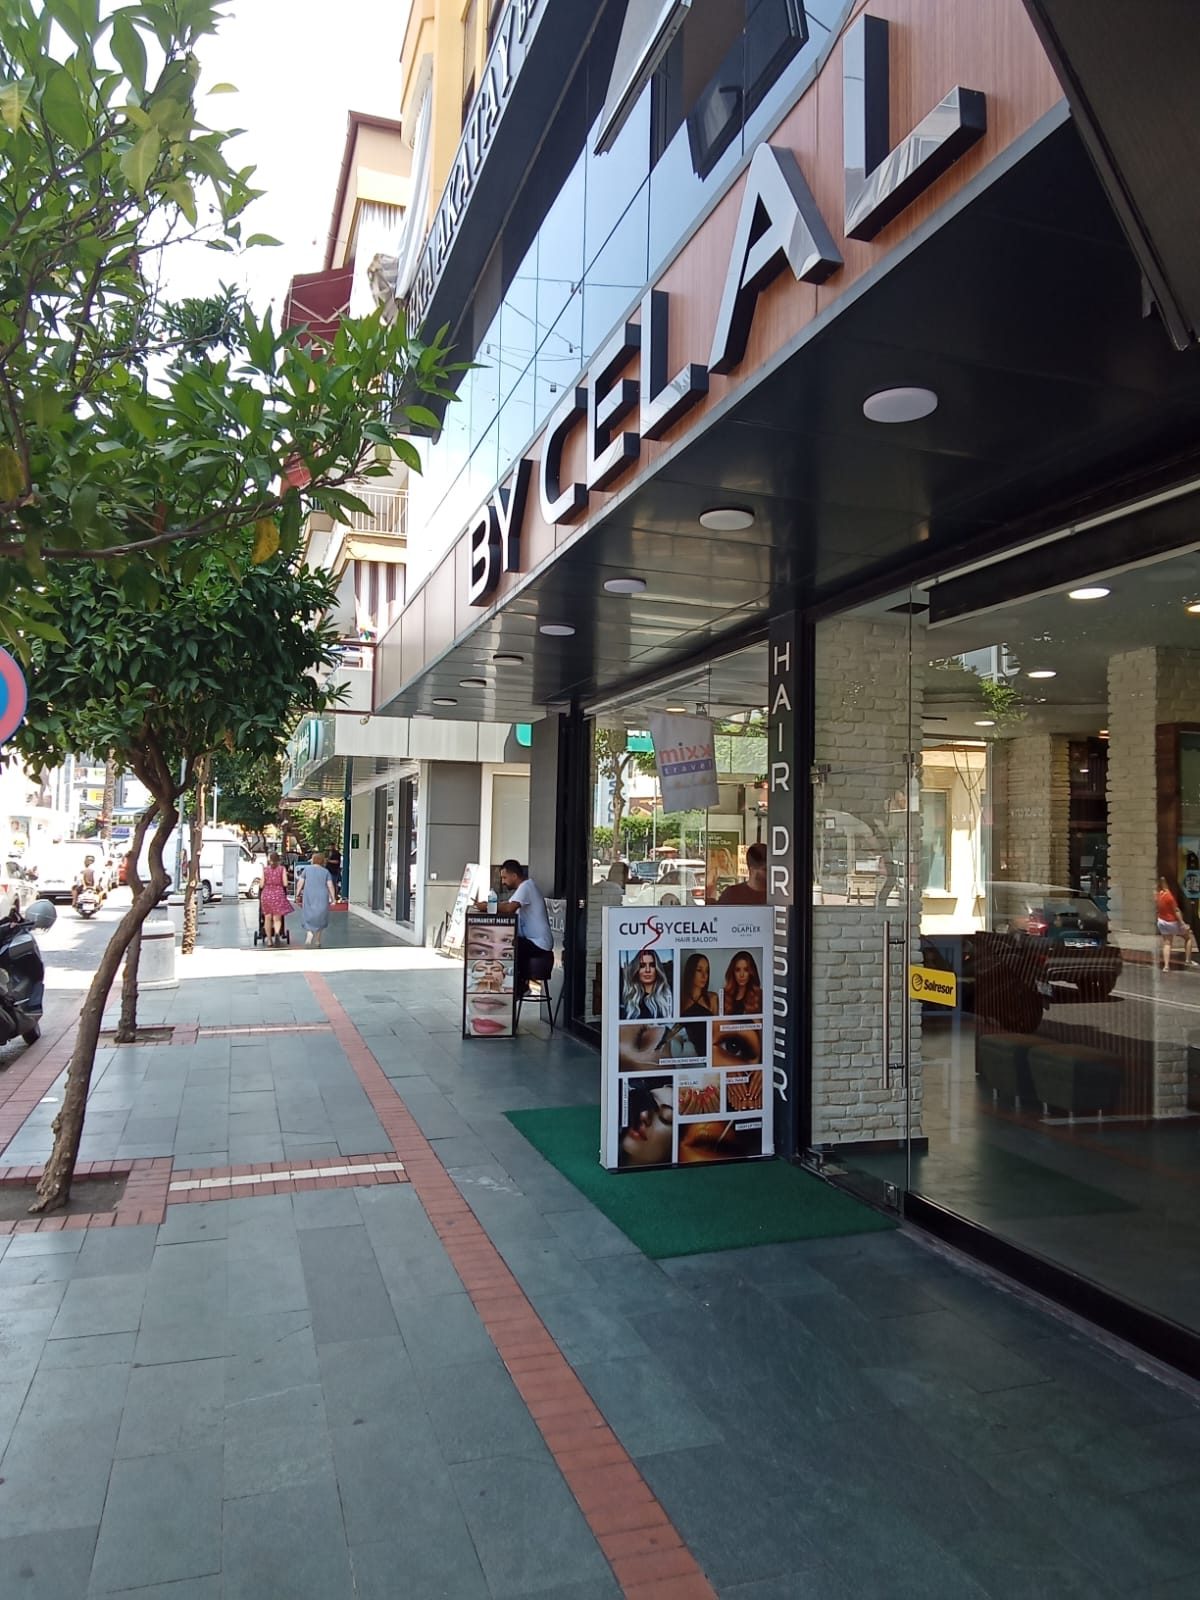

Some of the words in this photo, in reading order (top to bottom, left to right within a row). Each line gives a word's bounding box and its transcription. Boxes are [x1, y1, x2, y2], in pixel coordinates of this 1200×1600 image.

[467, 458, 533, 606] BY
[539, 14, 987, 526] CELAL
[659, 742, 712, 765] mixx
[771, 641, 792, 793] HAIR
[664, 759, 712, 775] travel
[769, 825, 790, 1102] DRESSER
[923, 979, 954, 995] Solresor
